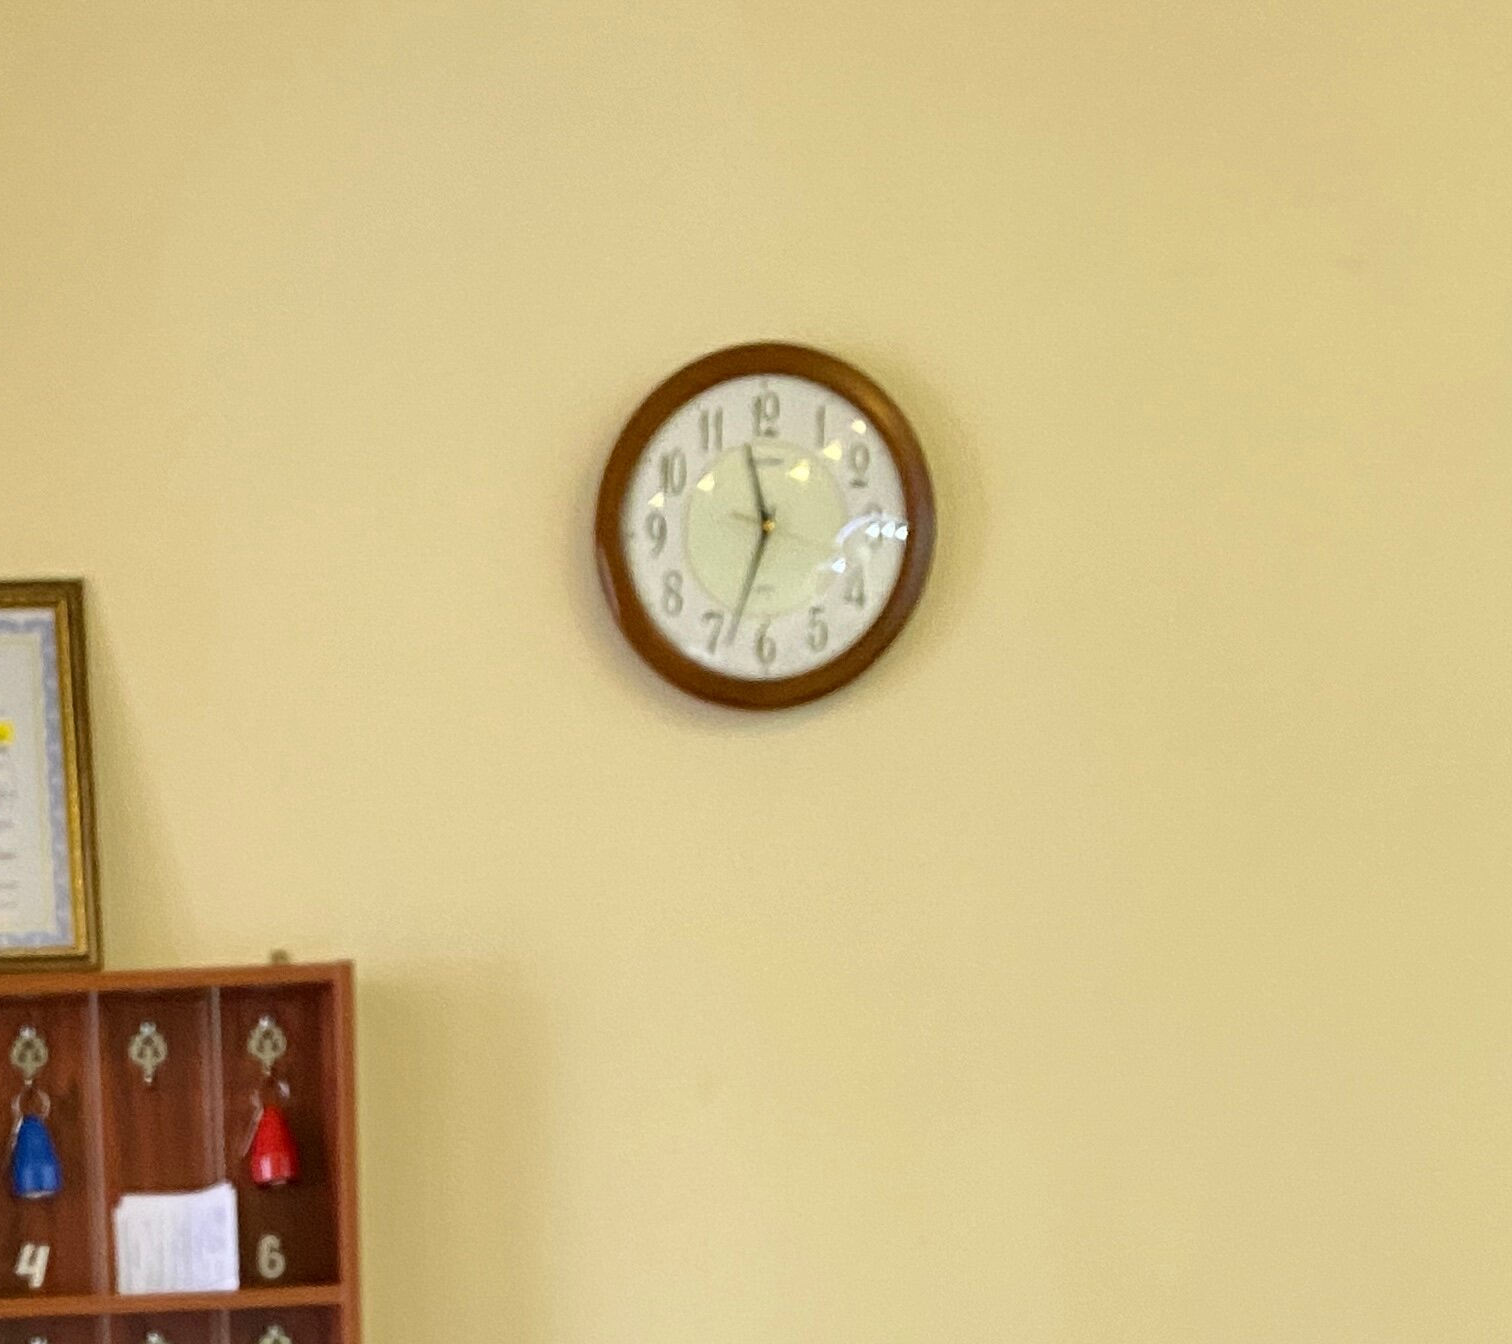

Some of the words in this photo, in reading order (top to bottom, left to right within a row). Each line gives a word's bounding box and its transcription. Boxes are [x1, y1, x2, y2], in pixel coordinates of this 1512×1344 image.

[699, 406, 724, 450] 11
[752, 392, 781, 437] 12
[816, 404, 827, 449] 1
[661, 448, 688, 498] 10
[645, 510, 668, 558] 9
[661, 568, 684, 618] 8
[843, 564, 866, 609] 4
[701, 610, 725, 656] 7
[754, 617, 777, 667] 6
[807, 604, 829, 652] 5
[14, 1242, 51, 1289] 4
[255, 1234, 286, 1279] 6
